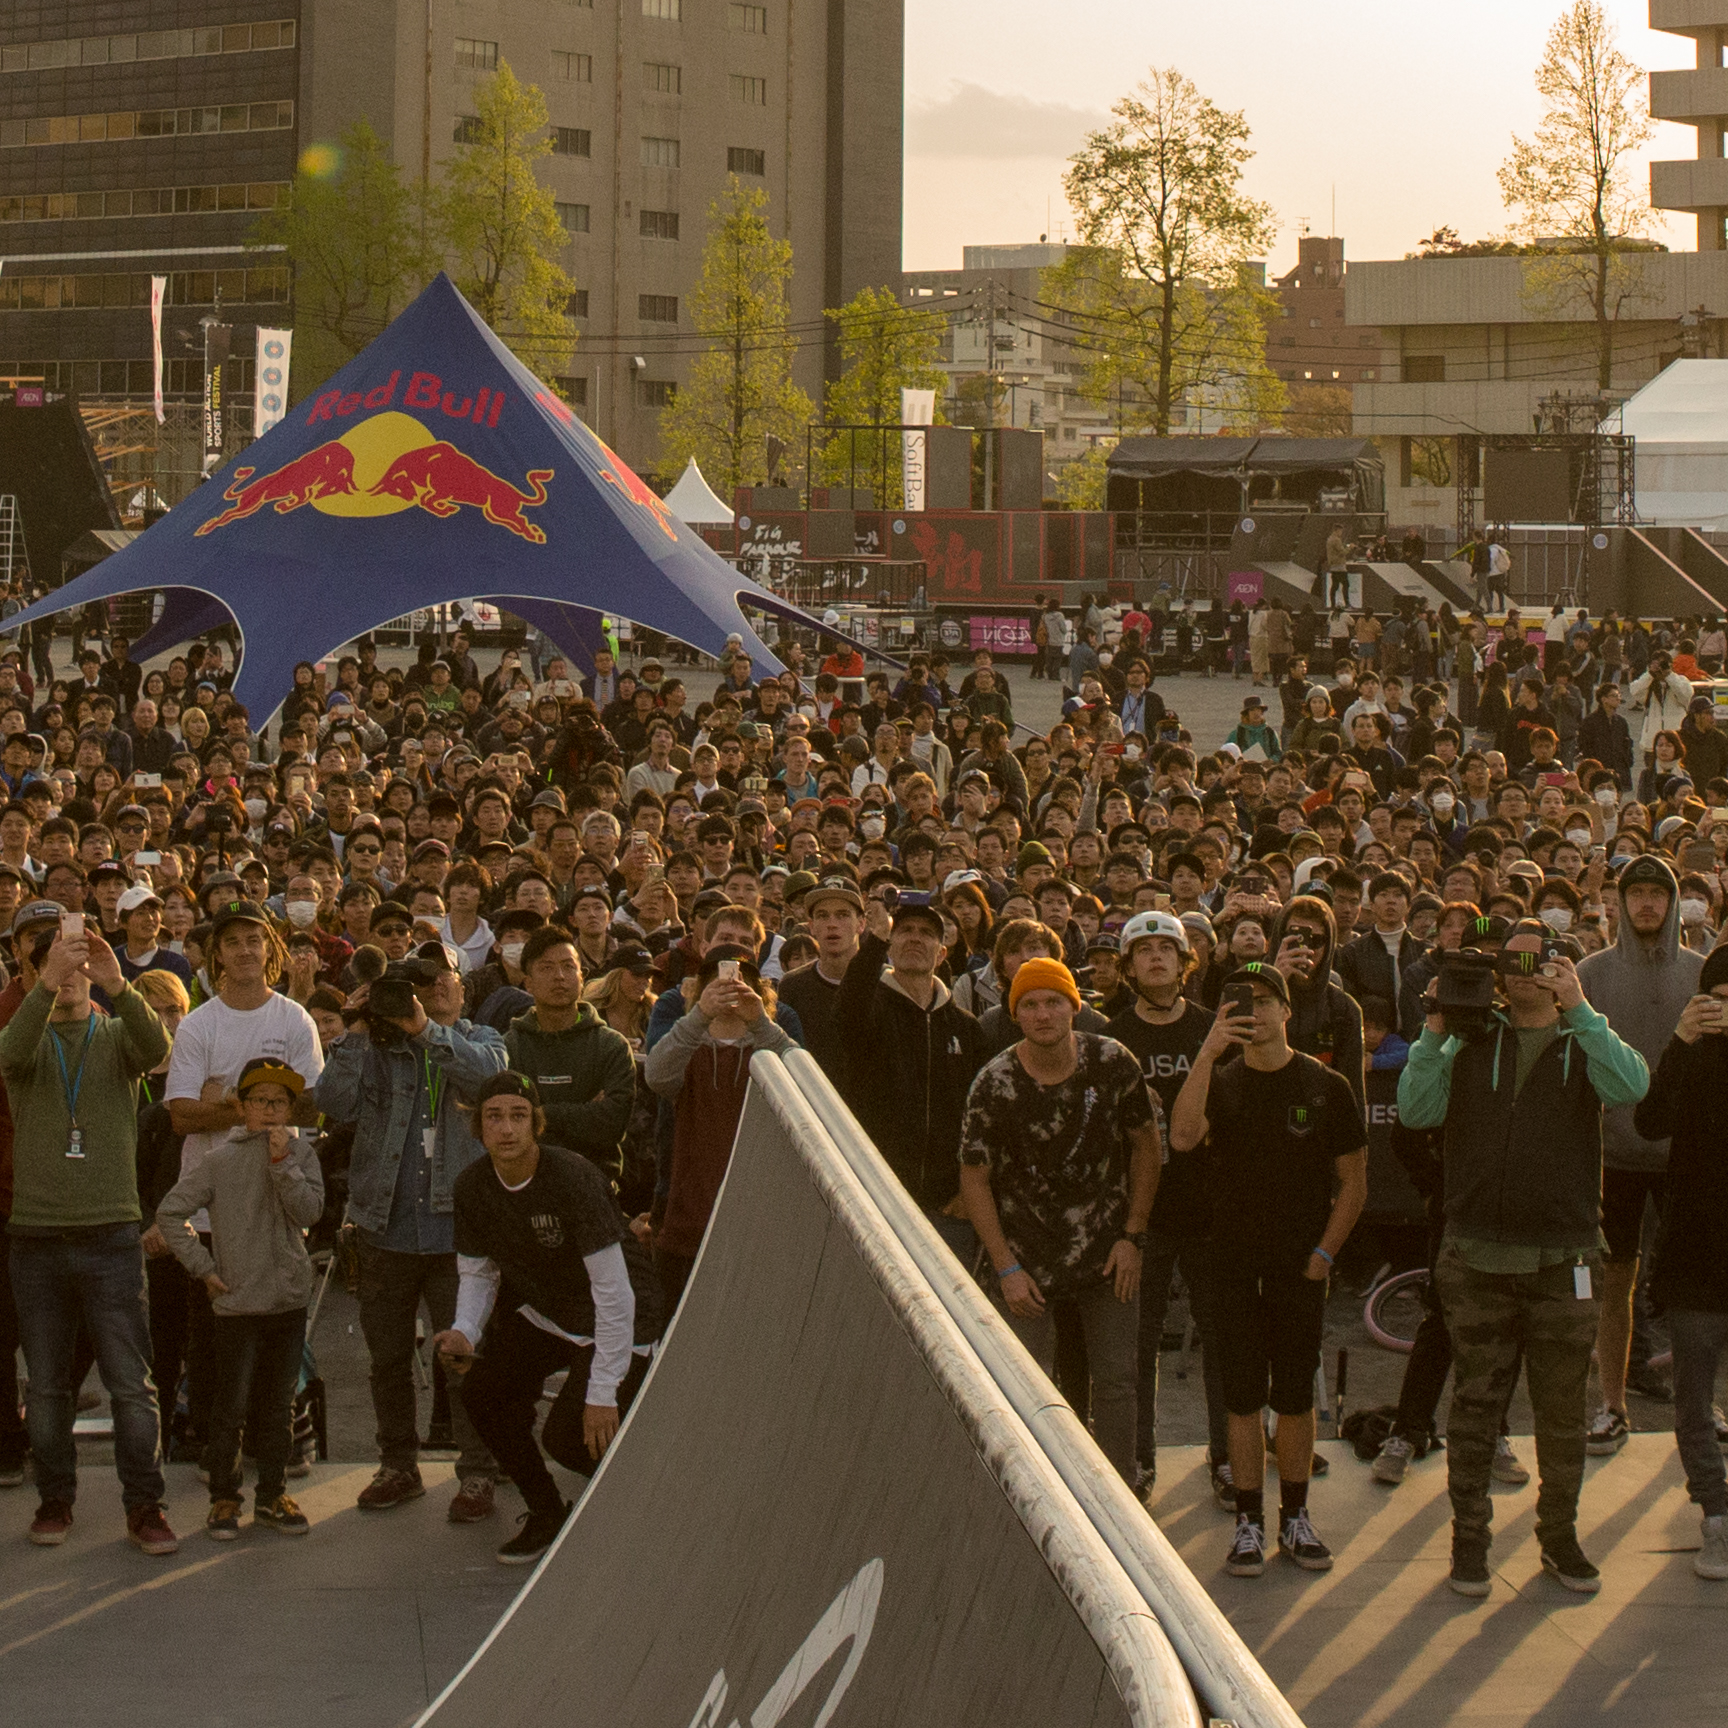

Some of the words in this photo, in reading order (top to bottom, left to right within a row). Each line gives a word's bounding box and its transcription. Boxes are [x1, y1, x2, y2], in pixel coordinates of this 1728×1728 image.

[212, 364, 221, 409] FESTIVAL
[305, 369, 402, 426] Red
[404, 371, 506, 429] Bull
[205, 412, 213, 447] WORLD
[213, 410, 222, 448] SPORTS
